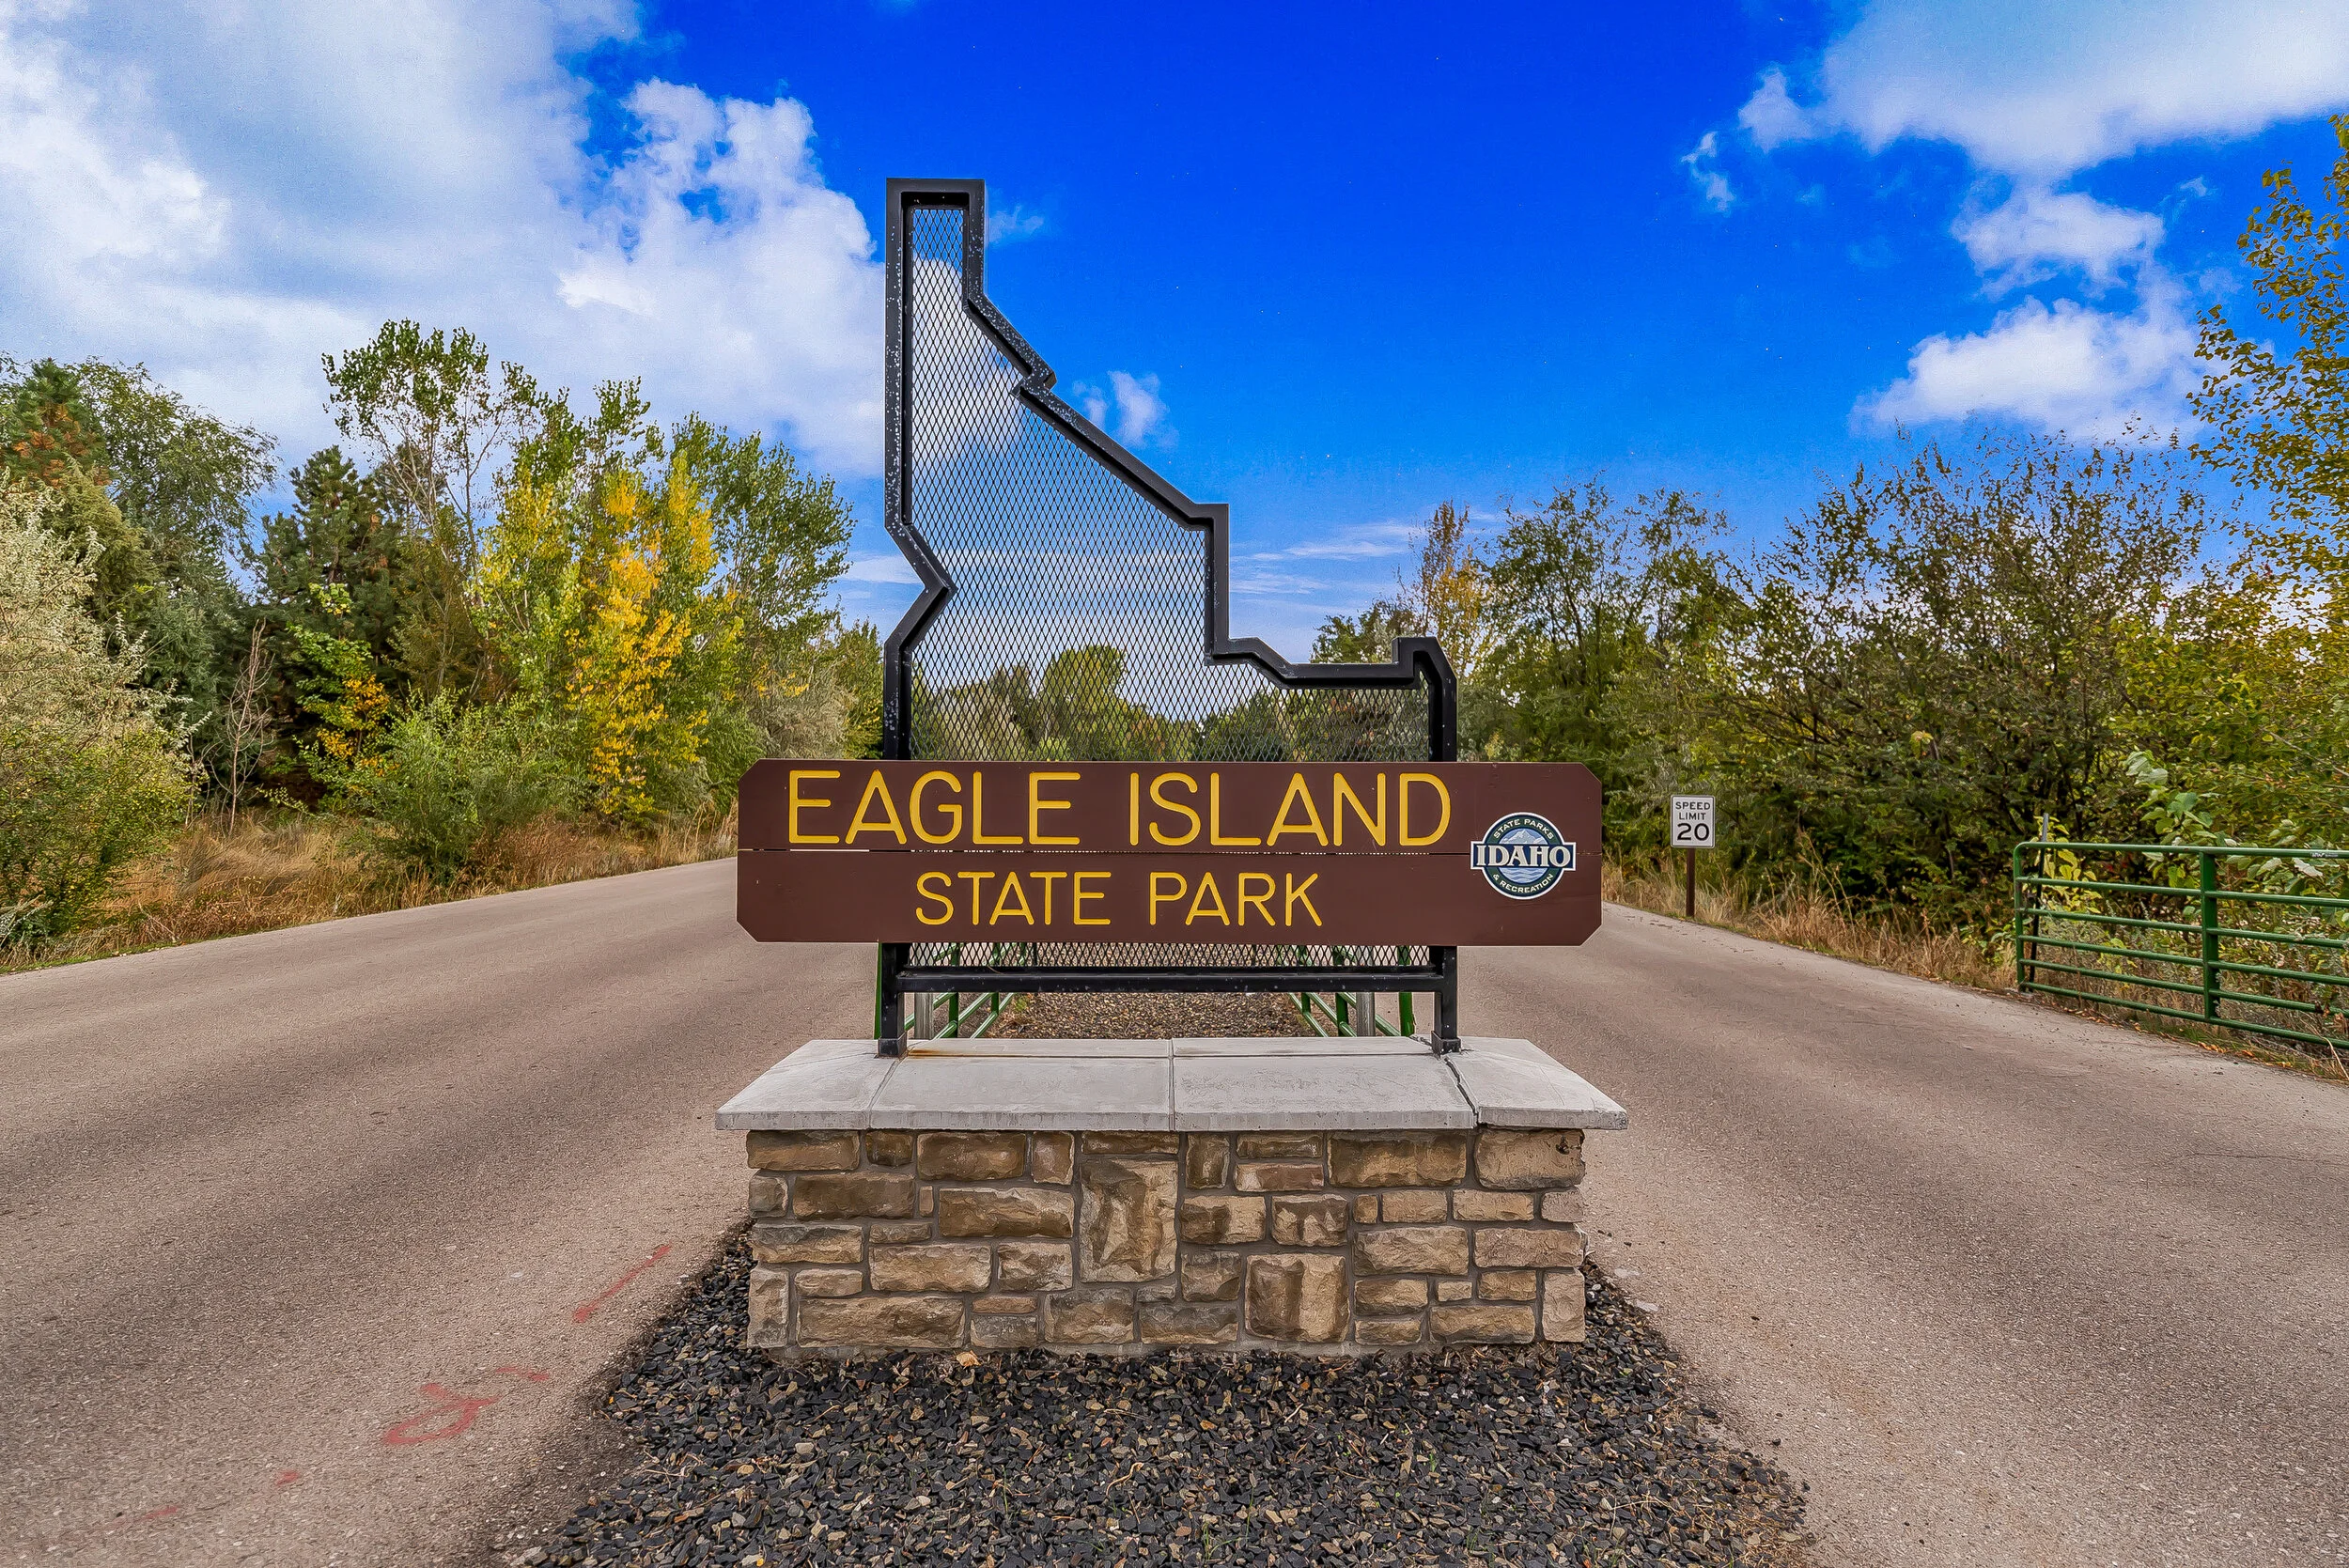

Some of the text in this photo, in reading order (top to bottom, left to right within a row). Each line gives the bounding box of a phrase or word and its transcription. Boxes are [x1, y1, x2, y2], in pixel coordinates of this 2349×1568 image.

[787, 768, 1452, 847] EAGLE ISLAND
[1675, 801, 1711, 810] SPEED
[1679, 812, 1706, 821] LIMIT
[1493, 818, 1554, 840] STATE PARKS
[1677, 822, 1710, 842] 20
[1476, 845, 1571, 868] IDAHO
[1500, 873, 1555, 893] RECREATION
[914, 870, 1324, 928] STATE PARK
